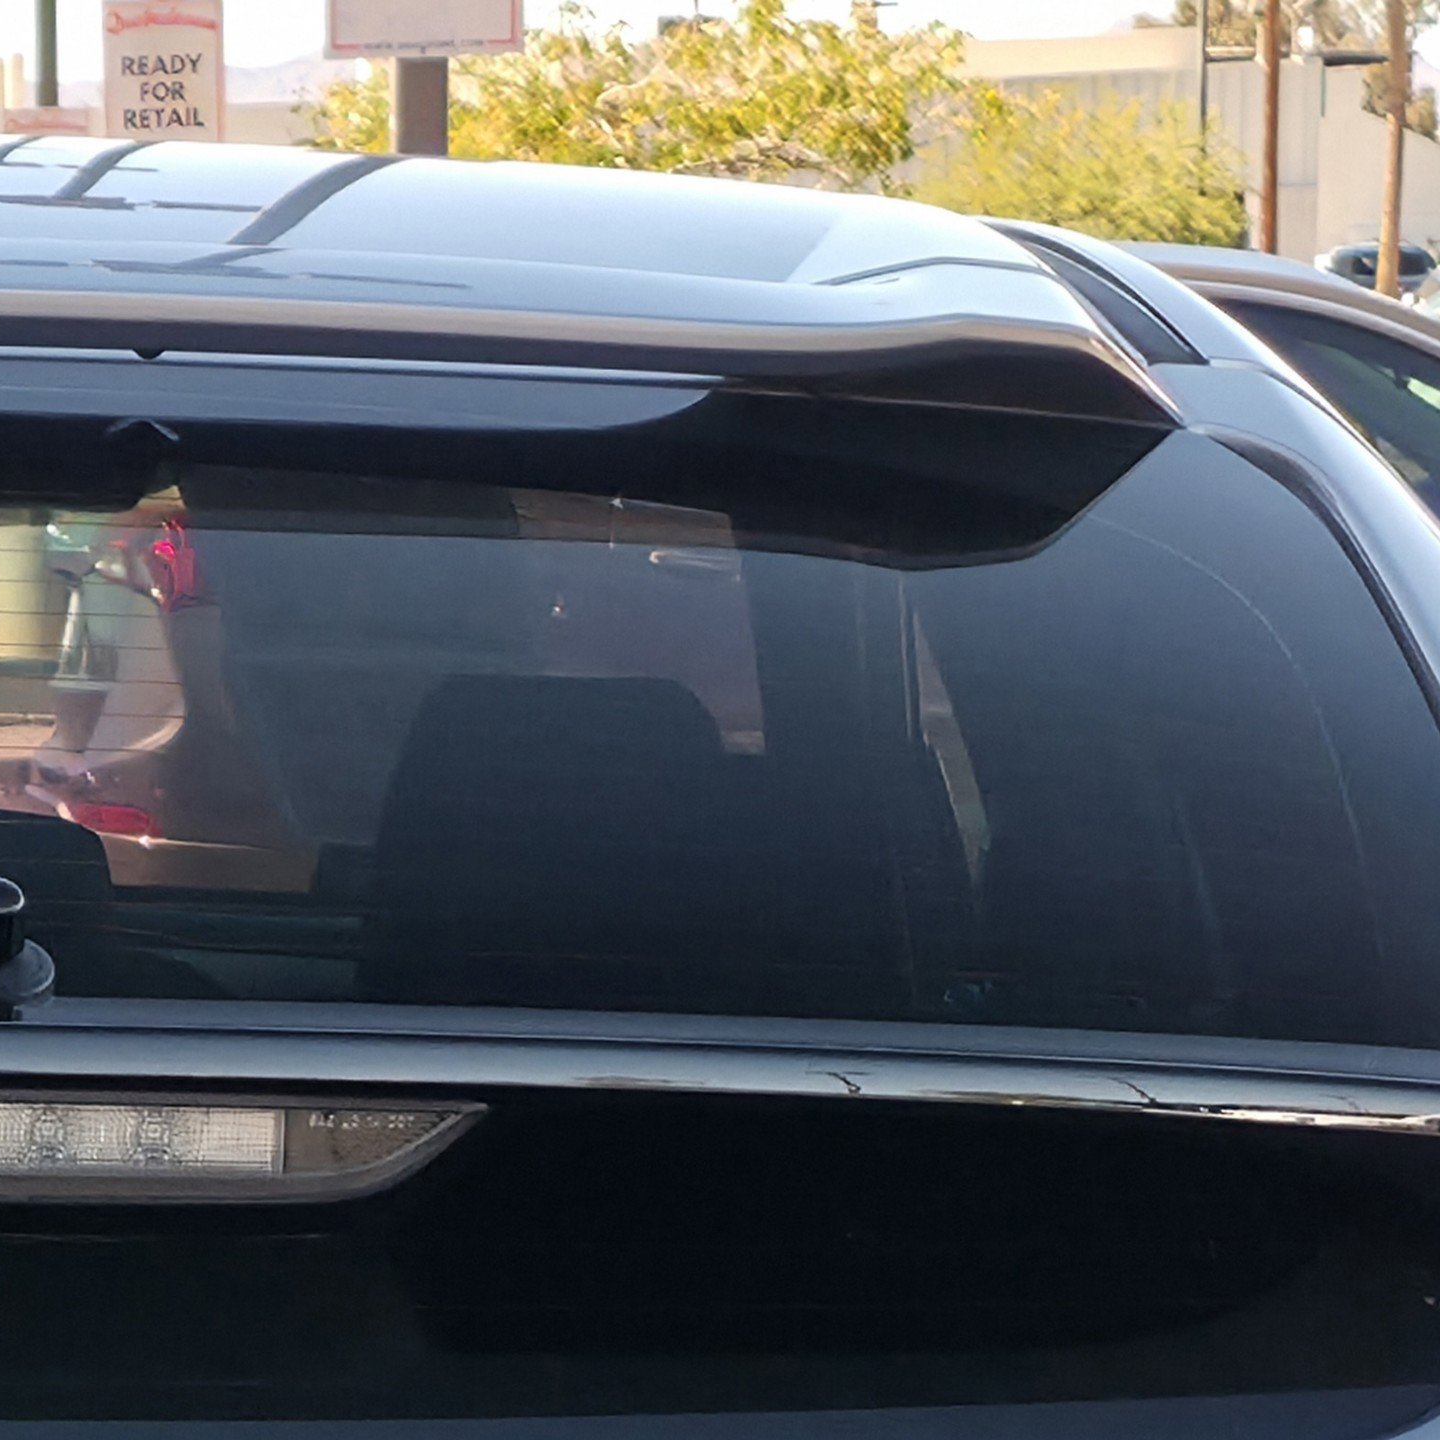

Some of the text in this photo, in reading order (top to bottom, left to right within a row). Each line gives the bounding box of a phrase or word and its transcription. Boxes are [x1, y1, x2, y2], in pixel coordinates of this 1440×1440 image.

[121, 53, 202, 76] READY
[139, 81, 187, 102] FOR
[123, 107, 205, 130] RETAIL
